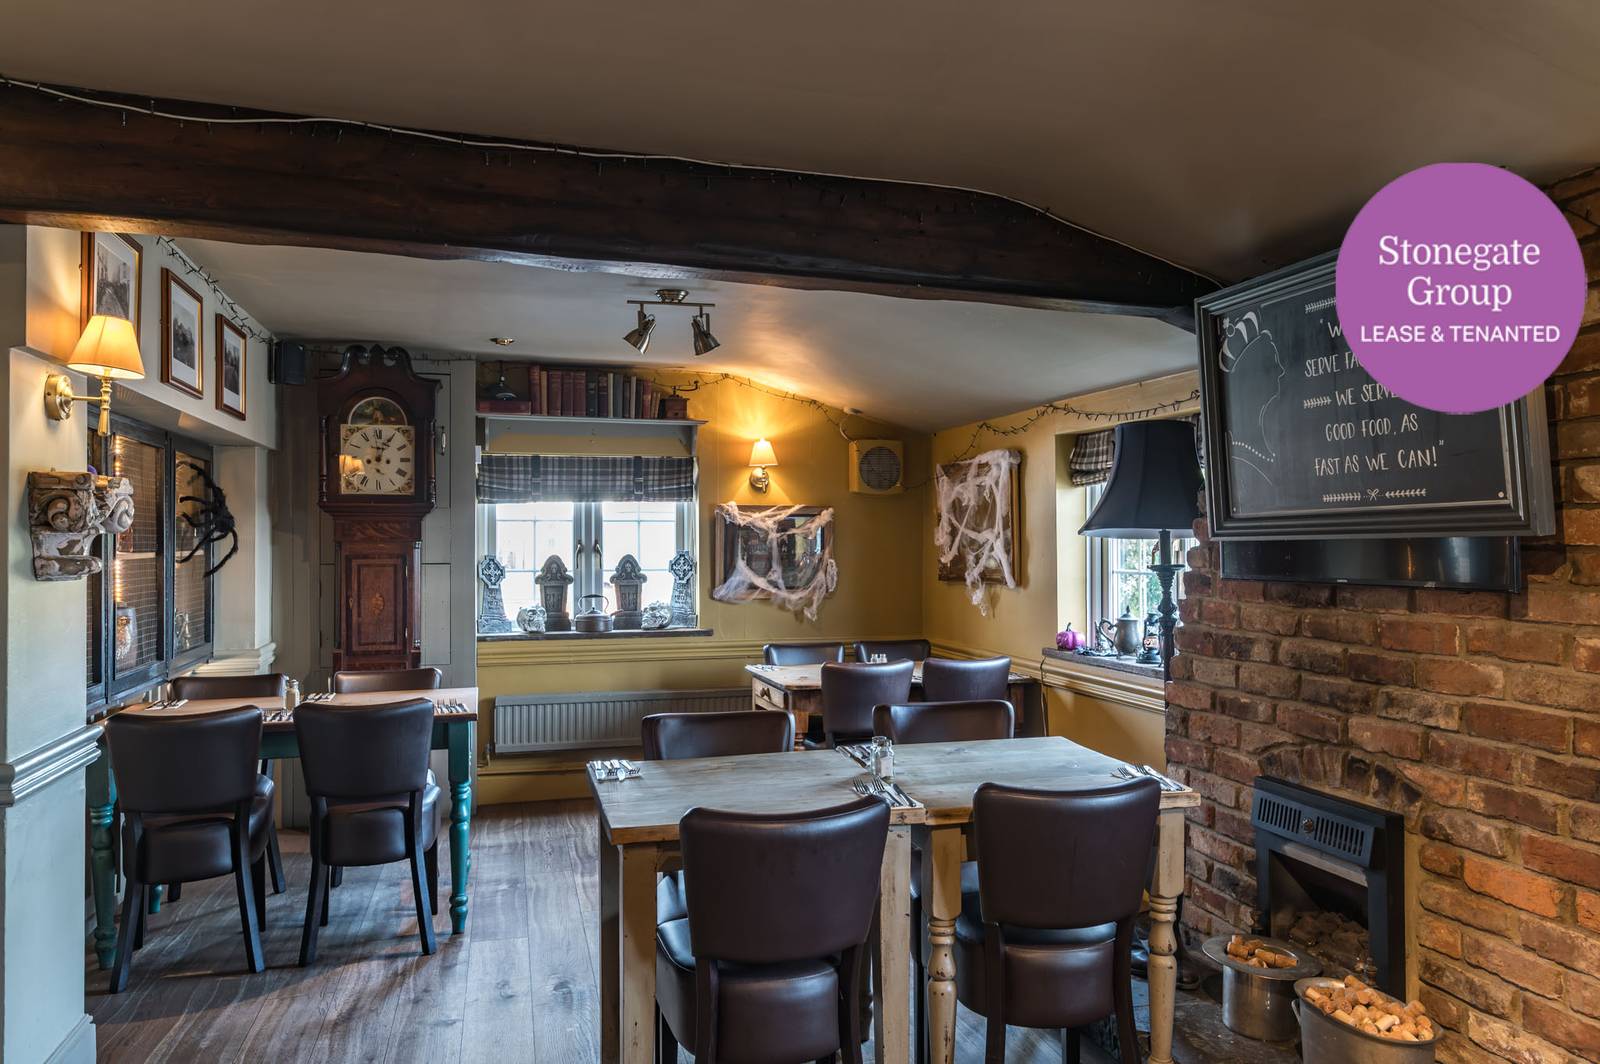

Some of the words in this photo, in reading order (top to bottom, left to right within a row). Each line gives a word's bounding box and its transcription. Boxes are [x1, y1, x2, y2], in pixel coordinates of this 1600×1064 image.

[1305, 354, 1341, 377] SERVE
[1335, 388, 1357, 406] WE
[1325, 422, 1355, 441] GOOD
[1401, 413, 1418, 432] AS
[1314, 457, 1340, 476] FAST
[1344, 454, 1360, 473] AS
[1365, 452, 1390, 471] WE
